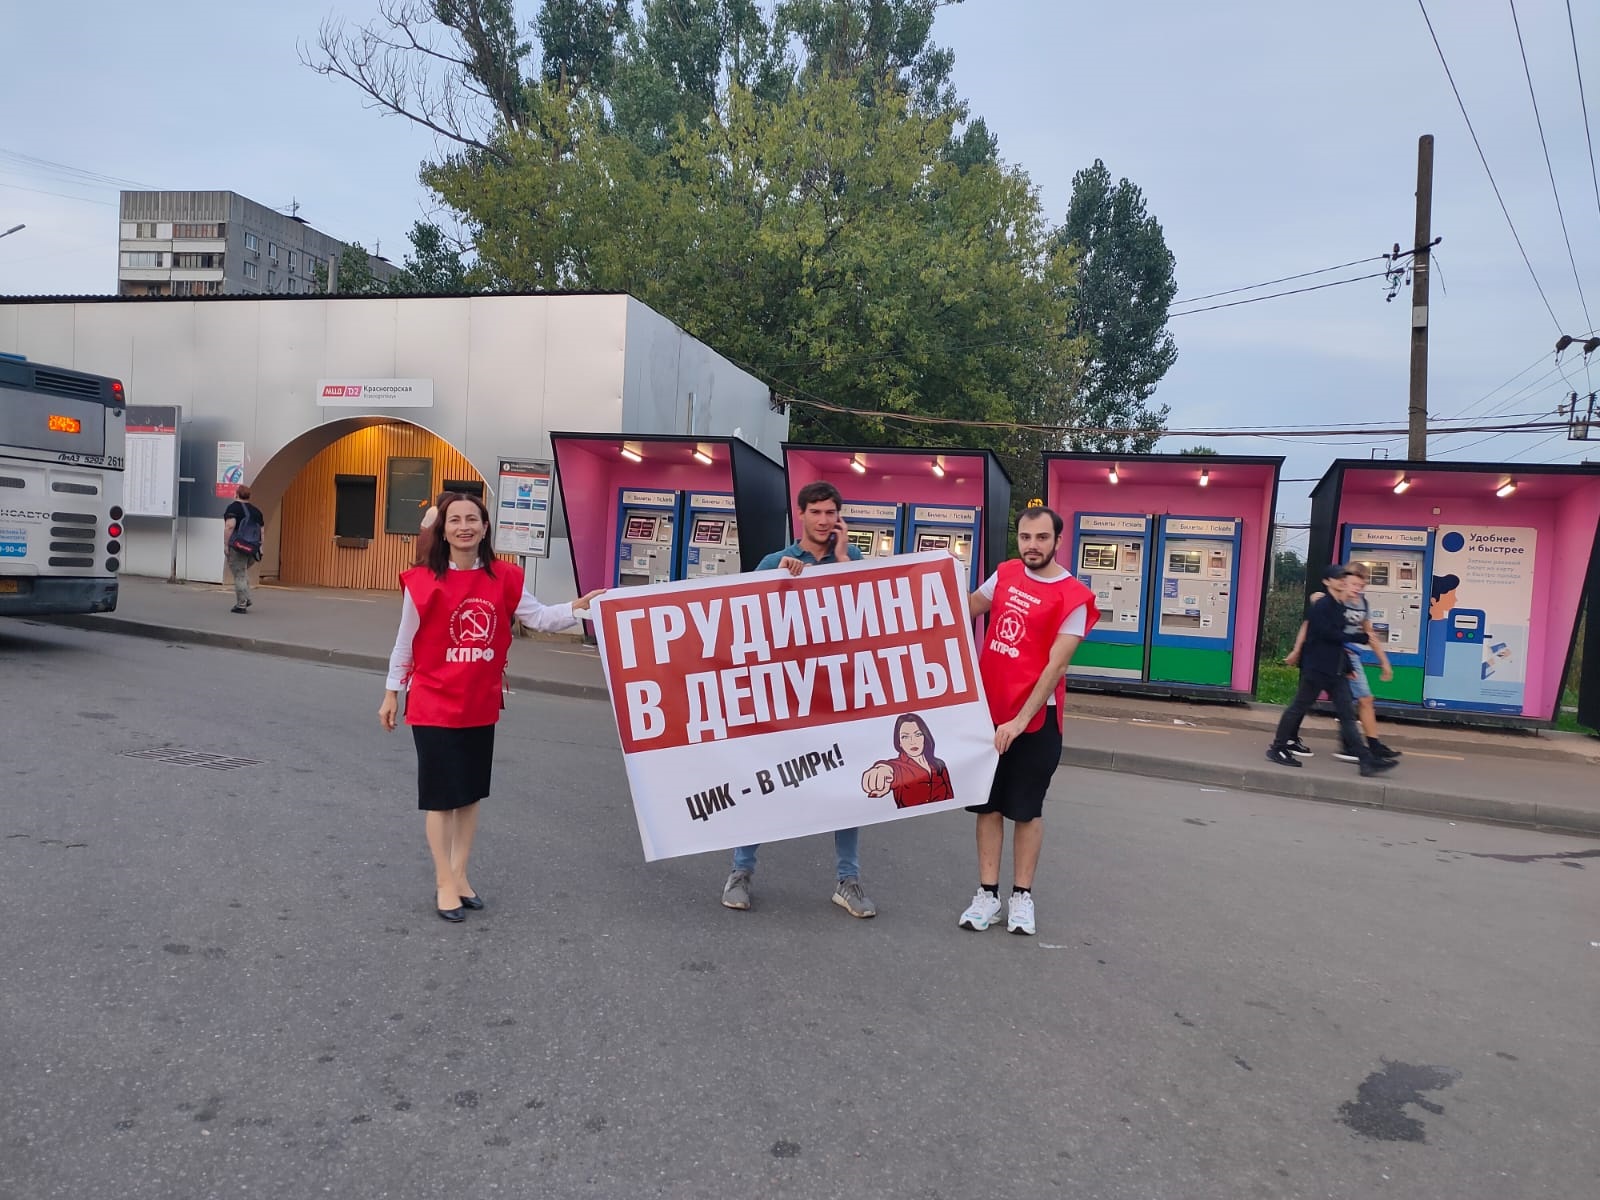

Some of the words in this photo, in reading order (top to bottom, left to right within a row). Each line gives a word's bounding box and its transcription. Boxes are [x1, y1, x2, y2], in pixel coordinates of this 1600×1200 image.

[325, 387, 343, 395] МЦД
[348, 387, 360, 395] D2
[363, 384, 413, 393] Красногорская
[1400, 534, 1424, 542] Tickets
[1469, 533, 1517, 543] Удобнее
[1477, 544, 1525, 555] быстрее
[616, 571, 955, 669] ГРУДИНИНА
[445, 647, 495, 662] КПРФ
[989, 638, 1020, 658] КПРФ
[625, 680, 665, 741] В
[685, 638, 968, 744] ДЕПУТАТЫ
[685, 782, 735, 822] ЦИК
[756, 769, 775, 795] В
[777, 743, 846, 788] ЦИРк!
